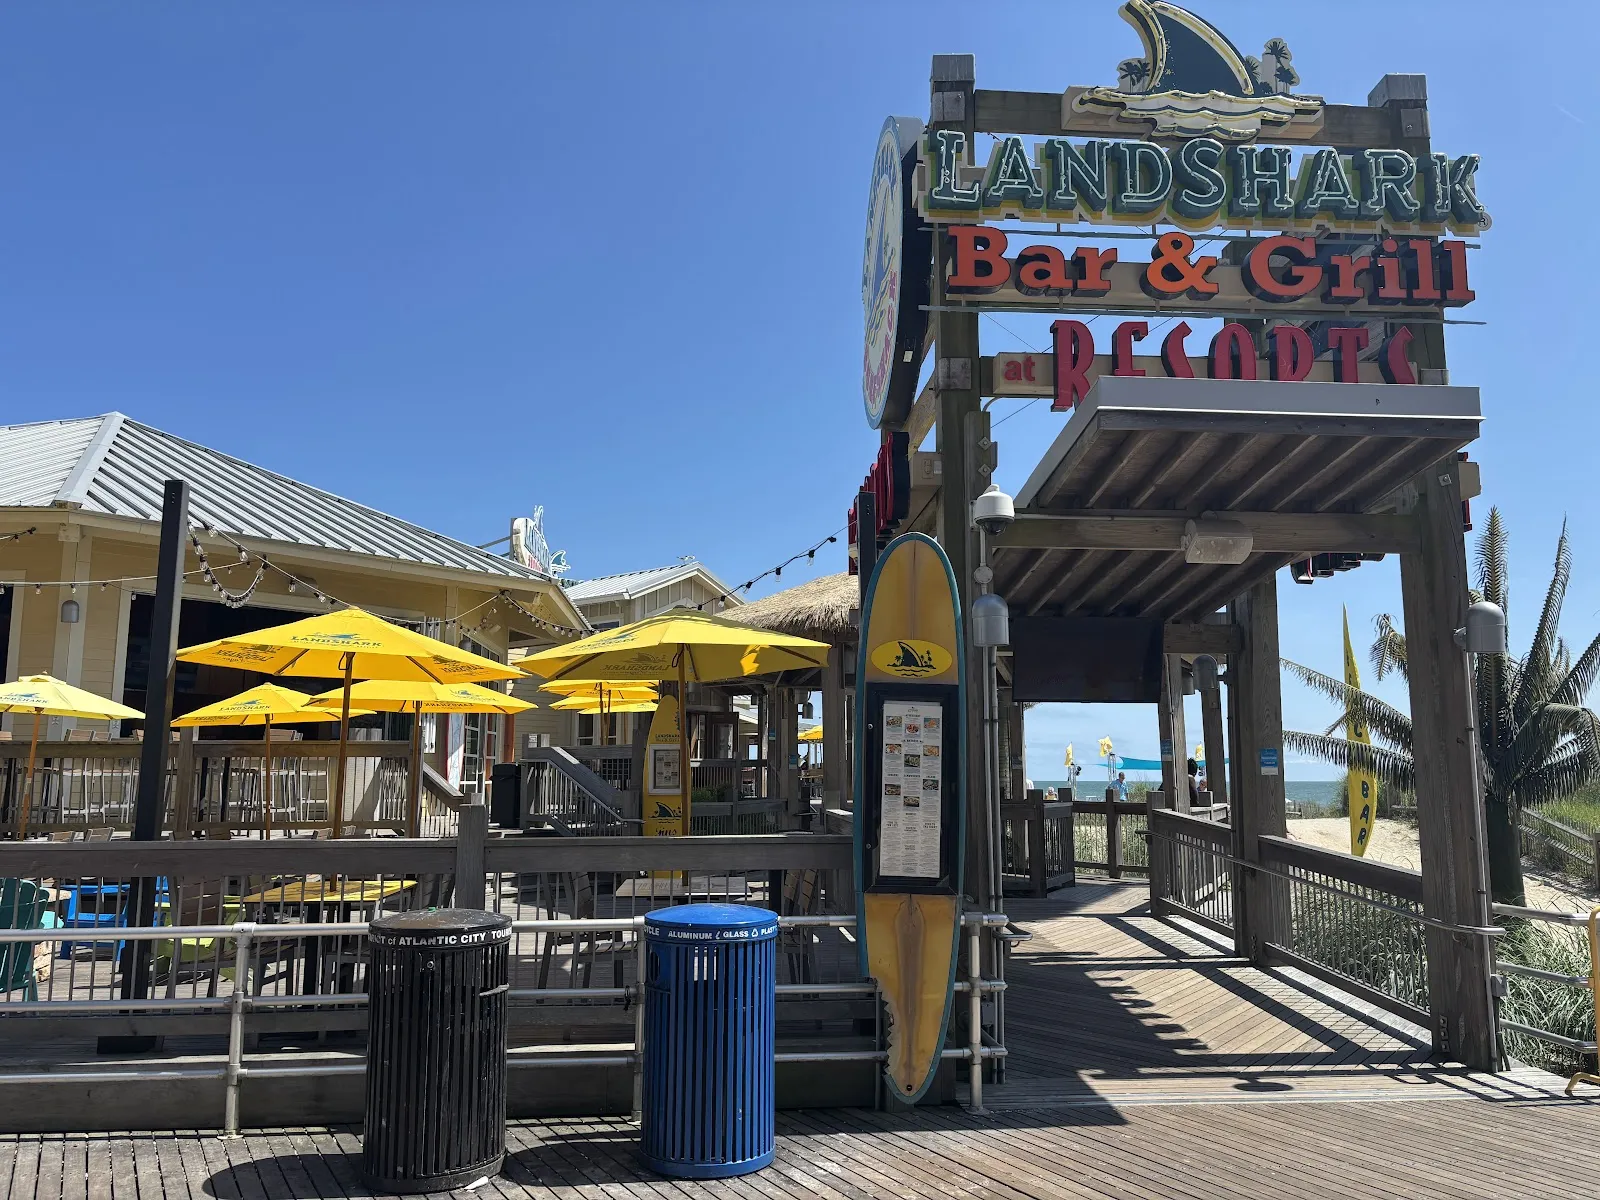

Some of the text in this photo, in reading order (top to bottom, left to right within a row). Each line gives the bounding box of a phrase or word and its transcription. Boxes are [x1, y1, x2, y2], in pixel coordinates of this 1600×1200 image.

[928, 128, 1484, 222] LANDSHARK
[946, 225, 1476, 301] Bar & Grill
[1003, 355, 1036, 382] at
[291, 635, 382, 647] LANDSHARK
[1357, 780, 1370, 846] BAR
[398, 935, 457, 946] ATLANTIC
[460, 932, 486, 943] CITY
[667, 930, 713, 940] ALUMINUM
[723, 930, 749, 938] GLASS
